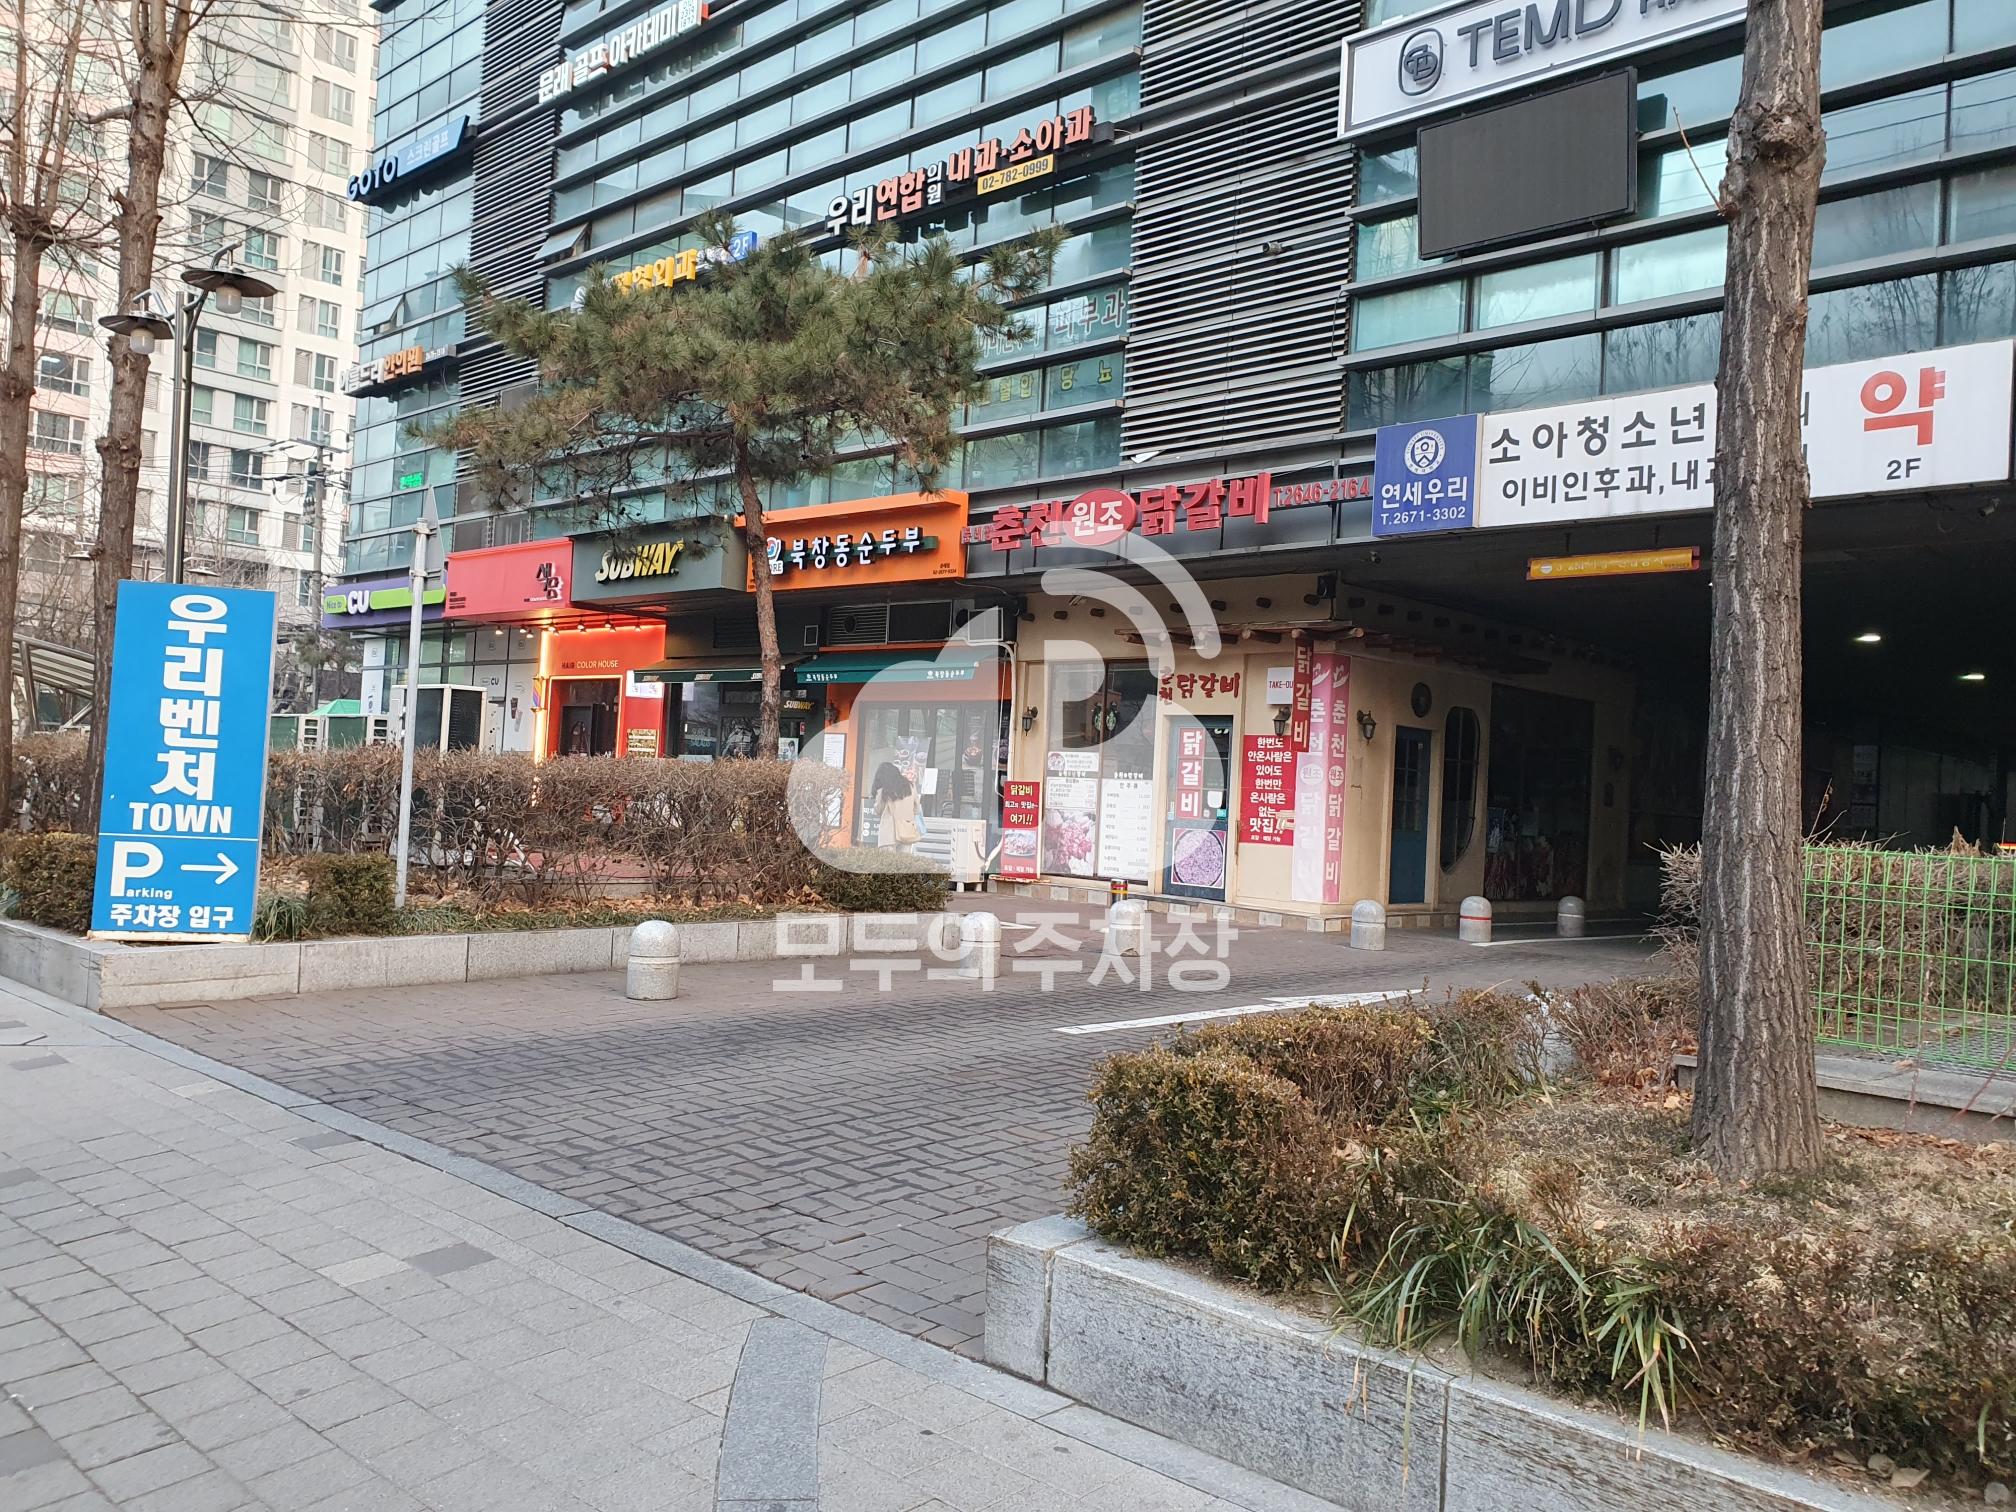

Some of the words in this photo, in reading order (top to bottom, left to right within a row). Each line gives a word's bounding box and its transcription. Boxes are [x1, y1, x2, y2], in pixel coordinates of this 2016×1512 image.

[538, 62, 572, 103] 문래
[573, 43, 608, 87] 골프
[609, 4, 678, 67] 아카데미
[347, 156, 398, 201] GOTO
[406, 130, 448, 165] 스크린골프
[981, 156, 1049, 191] 02-782-0999
[826, 167, 925, 235] 우리연합
[1054, 287, 1127, 338] 피부과
[384, 345, 425, 380] 한의원
[1860, 366, 1946, 446] 약
[1489, 402, 1706, 464] 소아청소년
[1886, 457, 1922, 481] 2F
[1381, 476, 1467, 509] 연세우리
[991, 500, 1061, 551] 춘천
[1071, 498, 1124, 536] 원조
[1140, 472, 1272, 537] 닭갈비
[1273, 476, 1370, 508] T.2646-2164
[1381, 506, 1466, 525] T.2671-3302
[595, 538, 685, 582] SUBWAY
[791, 527, 921, 570] 북창동순두부
[347, 590, 370, 615] CU
[576, 660, 597, 669] COLOR
[598, 659, 619, 668] HOUSE
[490, 677, 500, 686] CU
[1176, 672, 1241, 699] 닭갈비
[1269, 680, 1294, 689] TAKE-OU
[150, 594, 228, 801] 우리벤처
[784, 700, 814, 710] SUBWAY
[1294, 646, 1312, 749] 닭갈비
[1257, 737, 1284, 748] 한번도
[1331, 699, 1346, 758] 춘천
[1247, 751, 1293, 763] 안온사람은
[1255, 765, 1283, 776] 있어도
[1181, 731, 1203, 817] 닭갈비
[1255, 778, 1283, 790] 한번만
[1329, 769, 1344, 781] 원조
[1010, 784, 1033, 797] 닭갈비
[1250, 792, 1286, 804] 온사람은
[129, 802, 233, 834] TOWN
[1010, 814, 1033, 825] 여기!!
[1258, 806, 1277, 818] 없는
[1326, 793, 1343, 885] 닭갈비
[110, 903, 181, 928] 주차장
[189, 905, 234, 929] 입구
